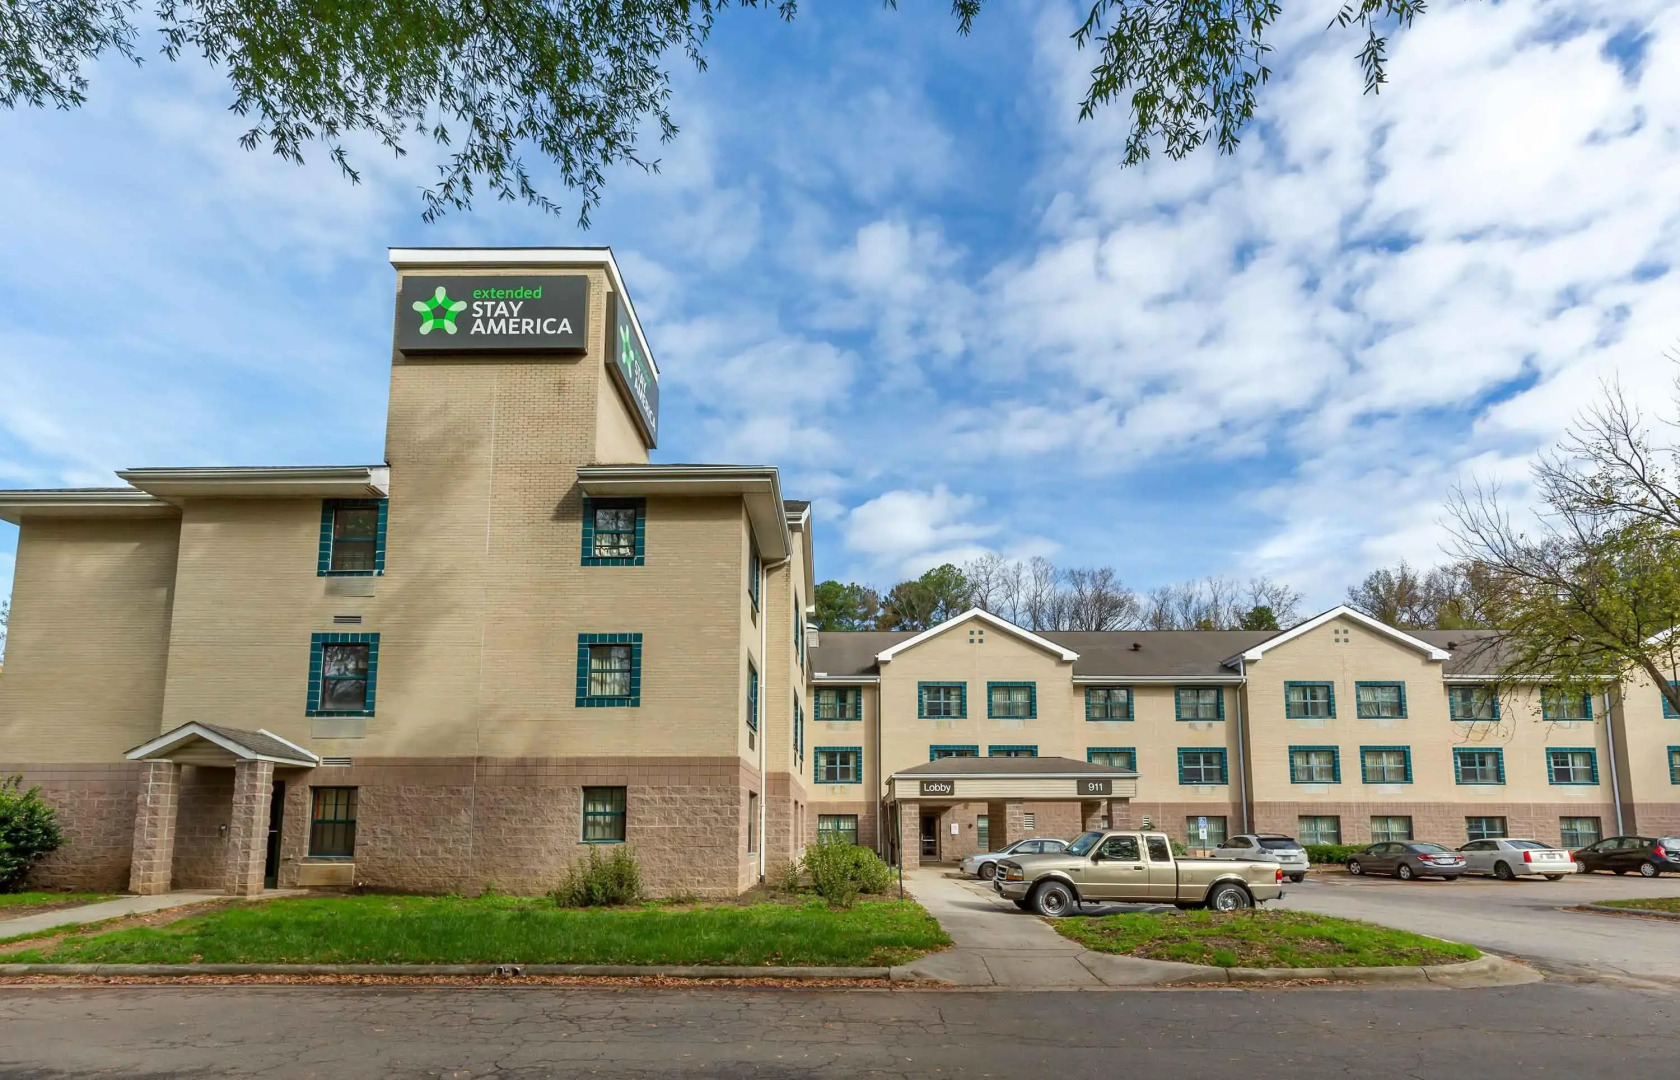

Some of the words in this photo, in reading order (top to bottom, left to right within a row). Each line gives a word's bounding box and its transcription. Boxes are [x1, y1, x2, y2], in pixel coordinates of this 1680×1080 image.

[473, 286, 542, 298] extended
[472, 301, 523, 317] STAY
[470, 318, 573, 334] AMERICA
[924, 783, 951, 793] Lobby
[1088, 783, 1103, 791] 911
